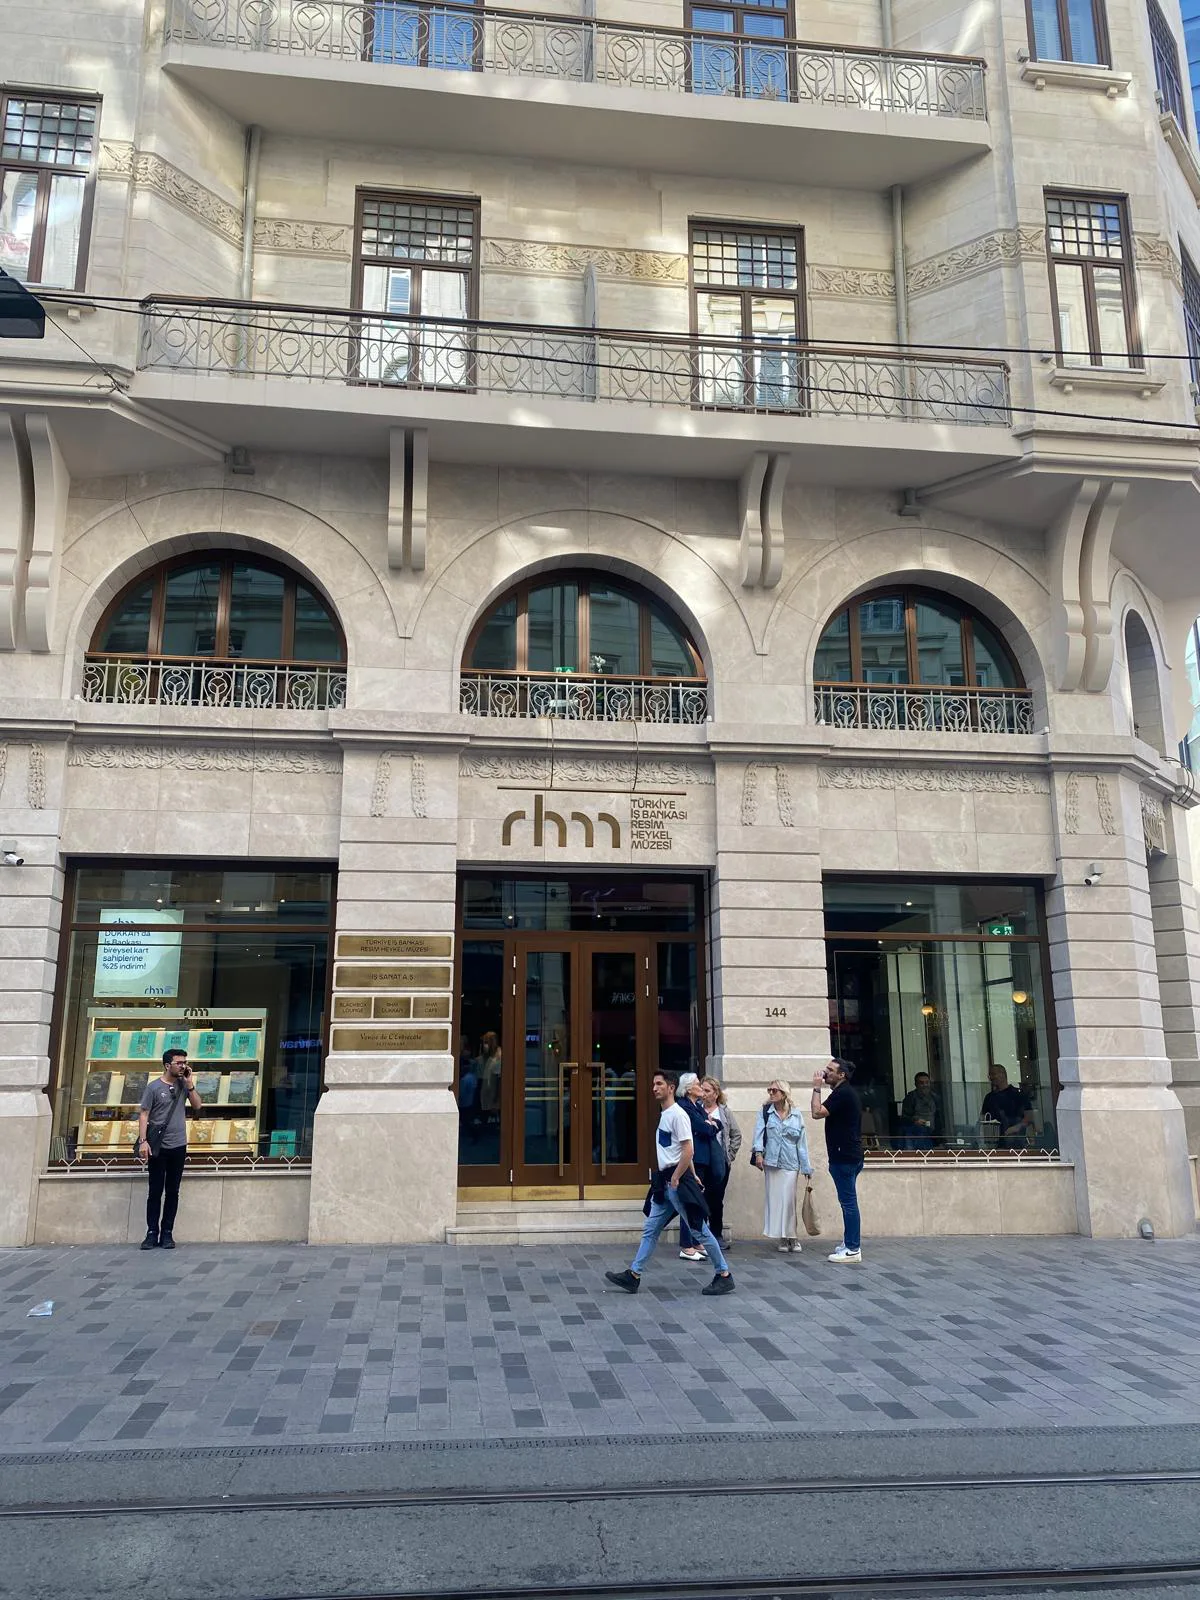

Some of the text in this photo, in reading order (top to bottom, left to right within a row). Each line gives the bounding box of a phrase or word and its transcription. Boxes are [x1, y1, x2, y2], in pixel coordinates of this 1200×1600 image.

[630, 797, 676, 809] TÜRKİYE
[630, 808, 688, 820] İŞ BANKASI
[630, 819, 665, 829] RESİM
[630, 830, 673, 840] HEYKEL
[630, 839, 672, 850] MÜZESİ
[103, 946, 133, 954] bireysel
[102, 954, 144, 963] sahiplerine
[102, 962, 147, 970] %25 indirim!
[765, 1007, 787, 1018] 144
